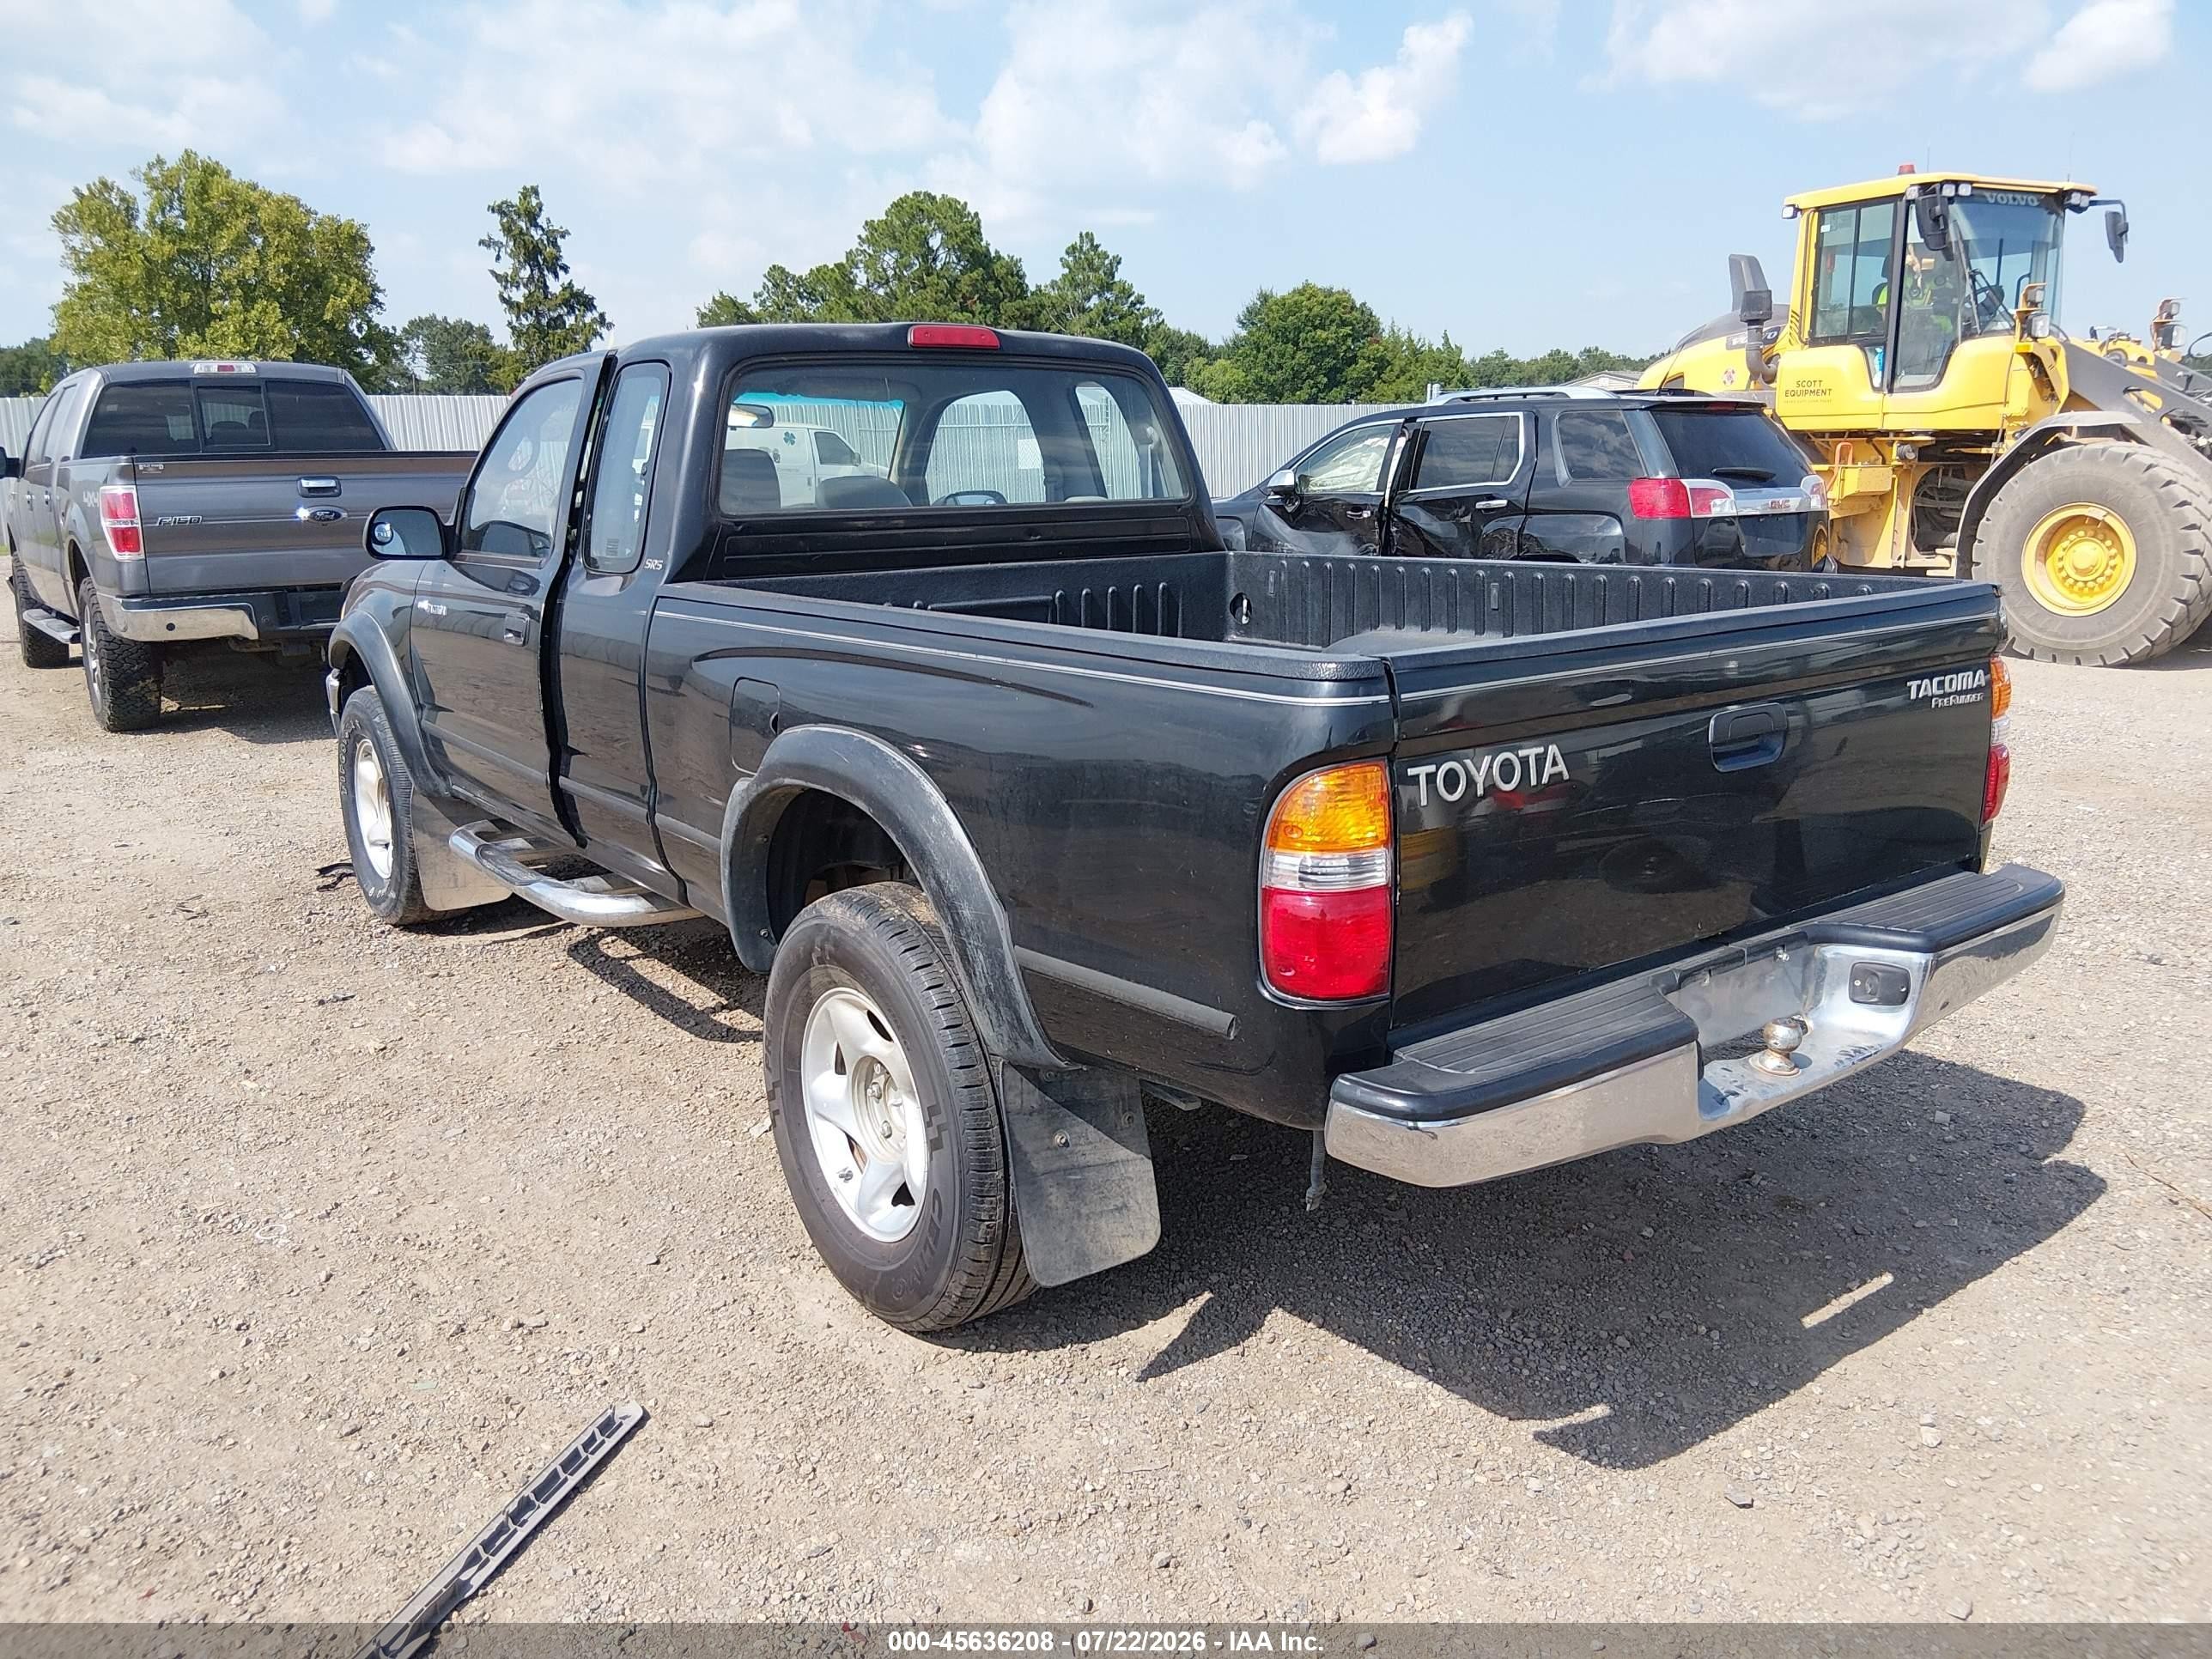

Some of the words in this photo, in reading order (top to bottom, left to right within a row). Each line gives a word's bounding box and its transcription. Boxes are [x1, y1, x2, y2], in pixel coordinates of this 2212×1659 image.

[1984, 191, 2041, 207] VOLVO
[1796, 380, 1823, 388] SCOTT
[1784, 388, 1832, 397] EQUIPMENT
[1768, 499, 1790, 509] GMC
[1906, 669, 1986, 700] TACOMA
[1407, 744, 1570, 807] TOYOTA
